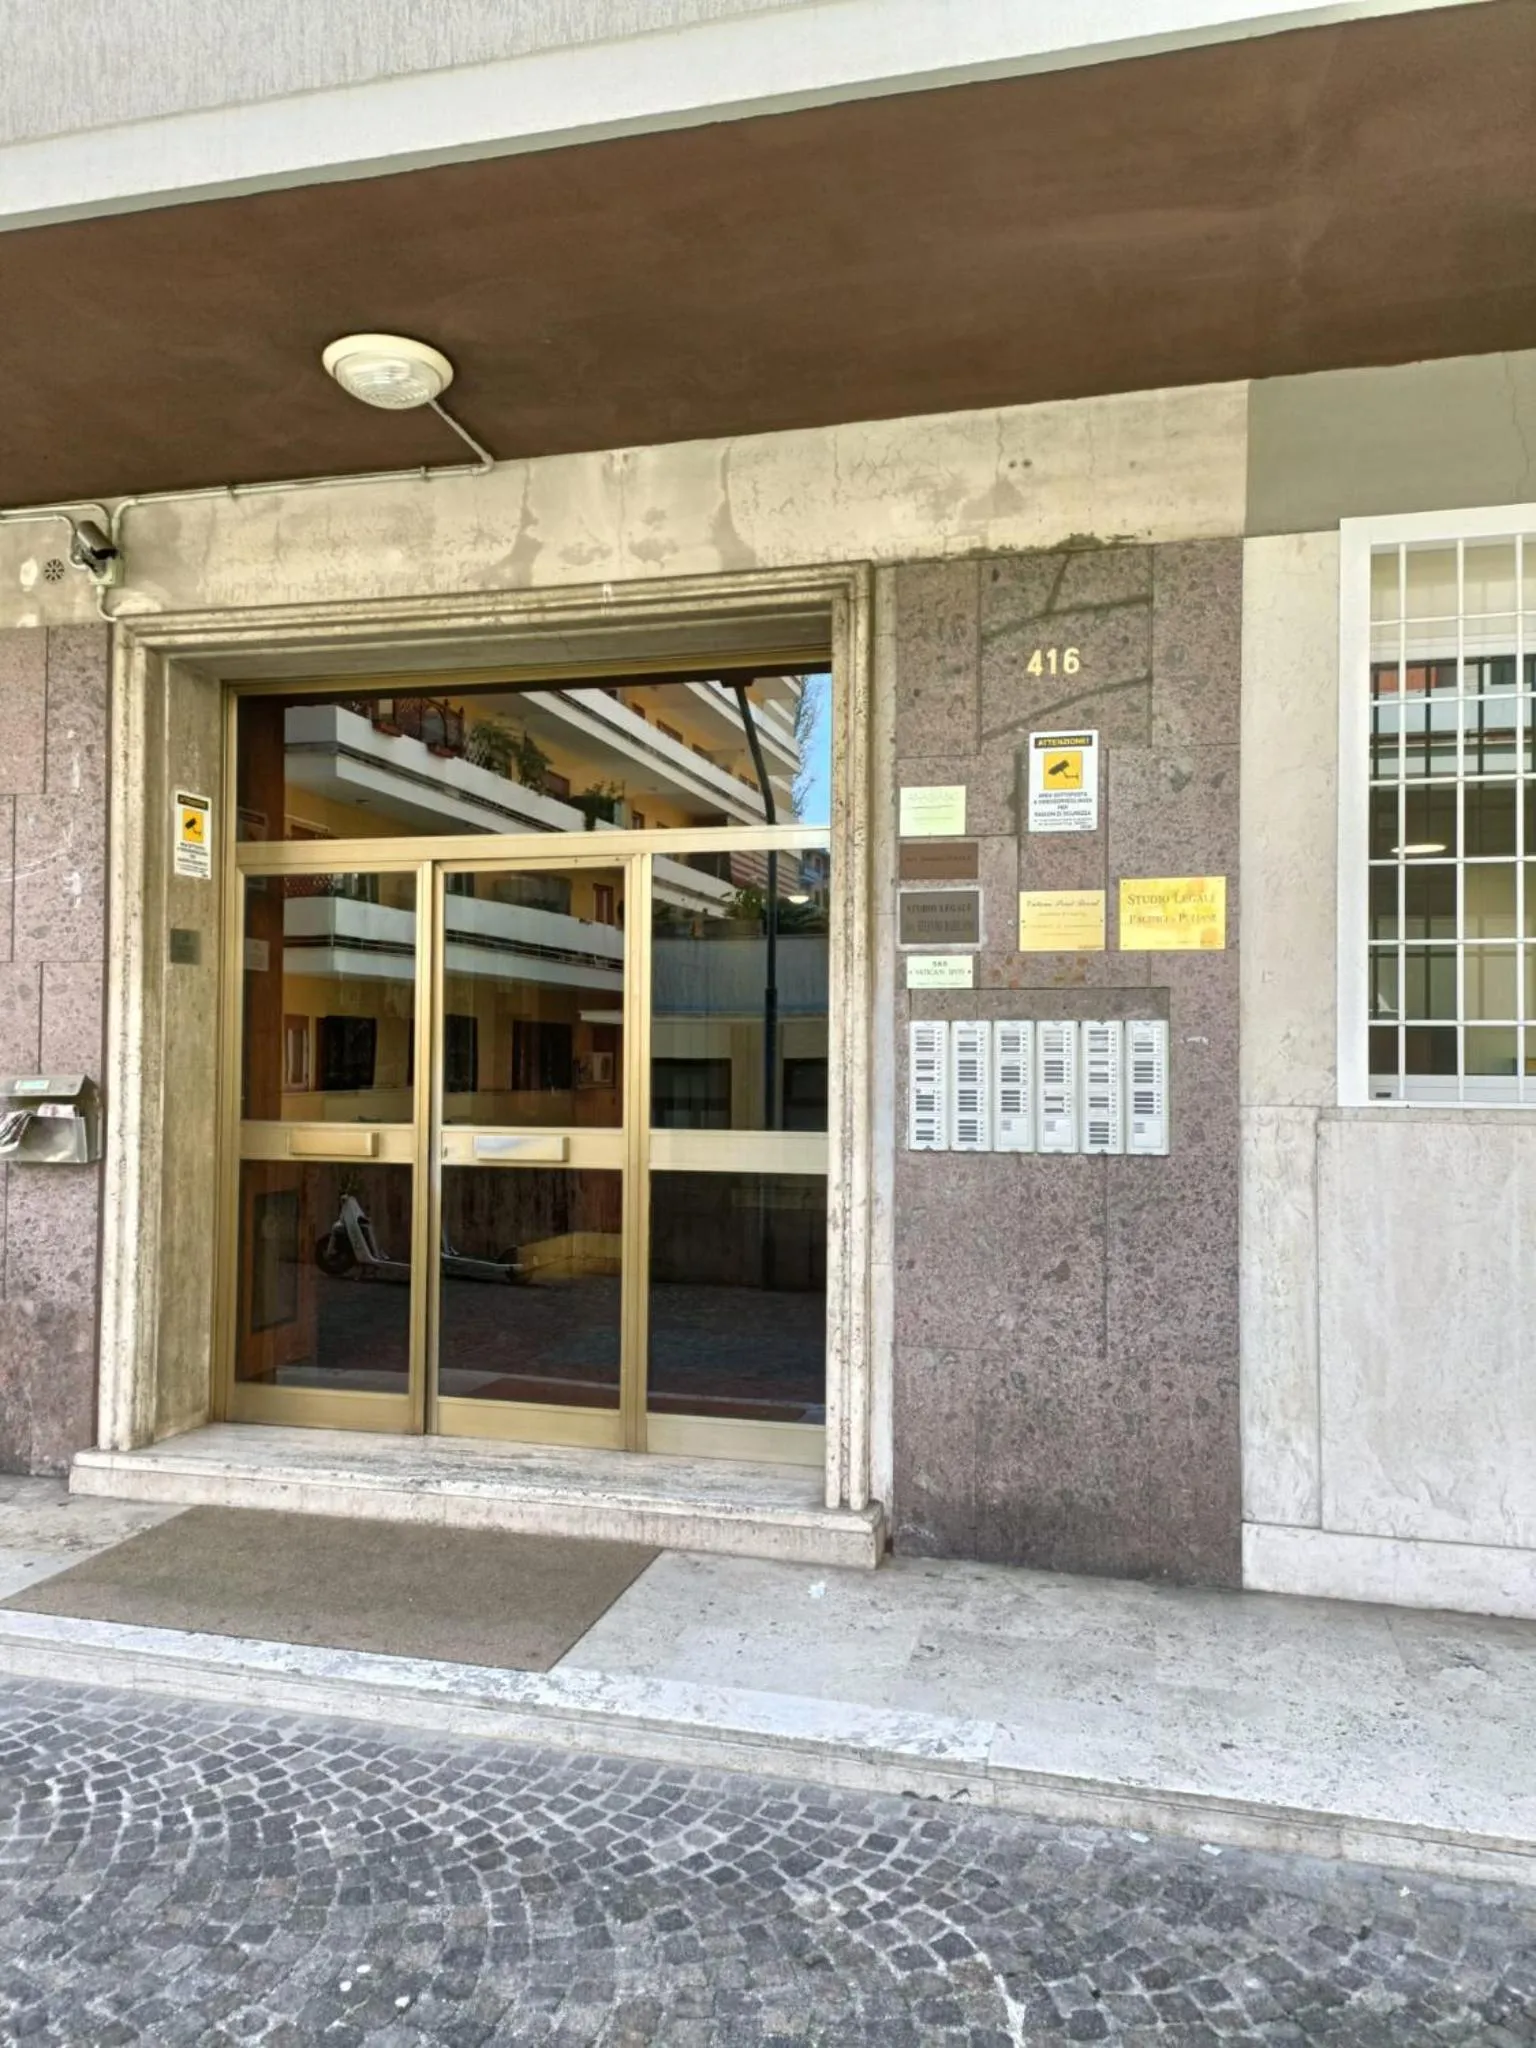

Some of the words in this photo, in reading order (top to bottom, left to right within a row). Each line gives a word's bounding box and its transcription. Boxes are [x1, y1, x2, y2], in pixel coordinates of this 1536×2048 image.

[1027, 648, 1080, 676] 416
[1127, 894, 1170, 906] STUDIO
[1174, 892, 1216, 904] LEGALE
[906, 903, 938, 913] STUDIO
[939, 902, 973, 913] LEGALE
